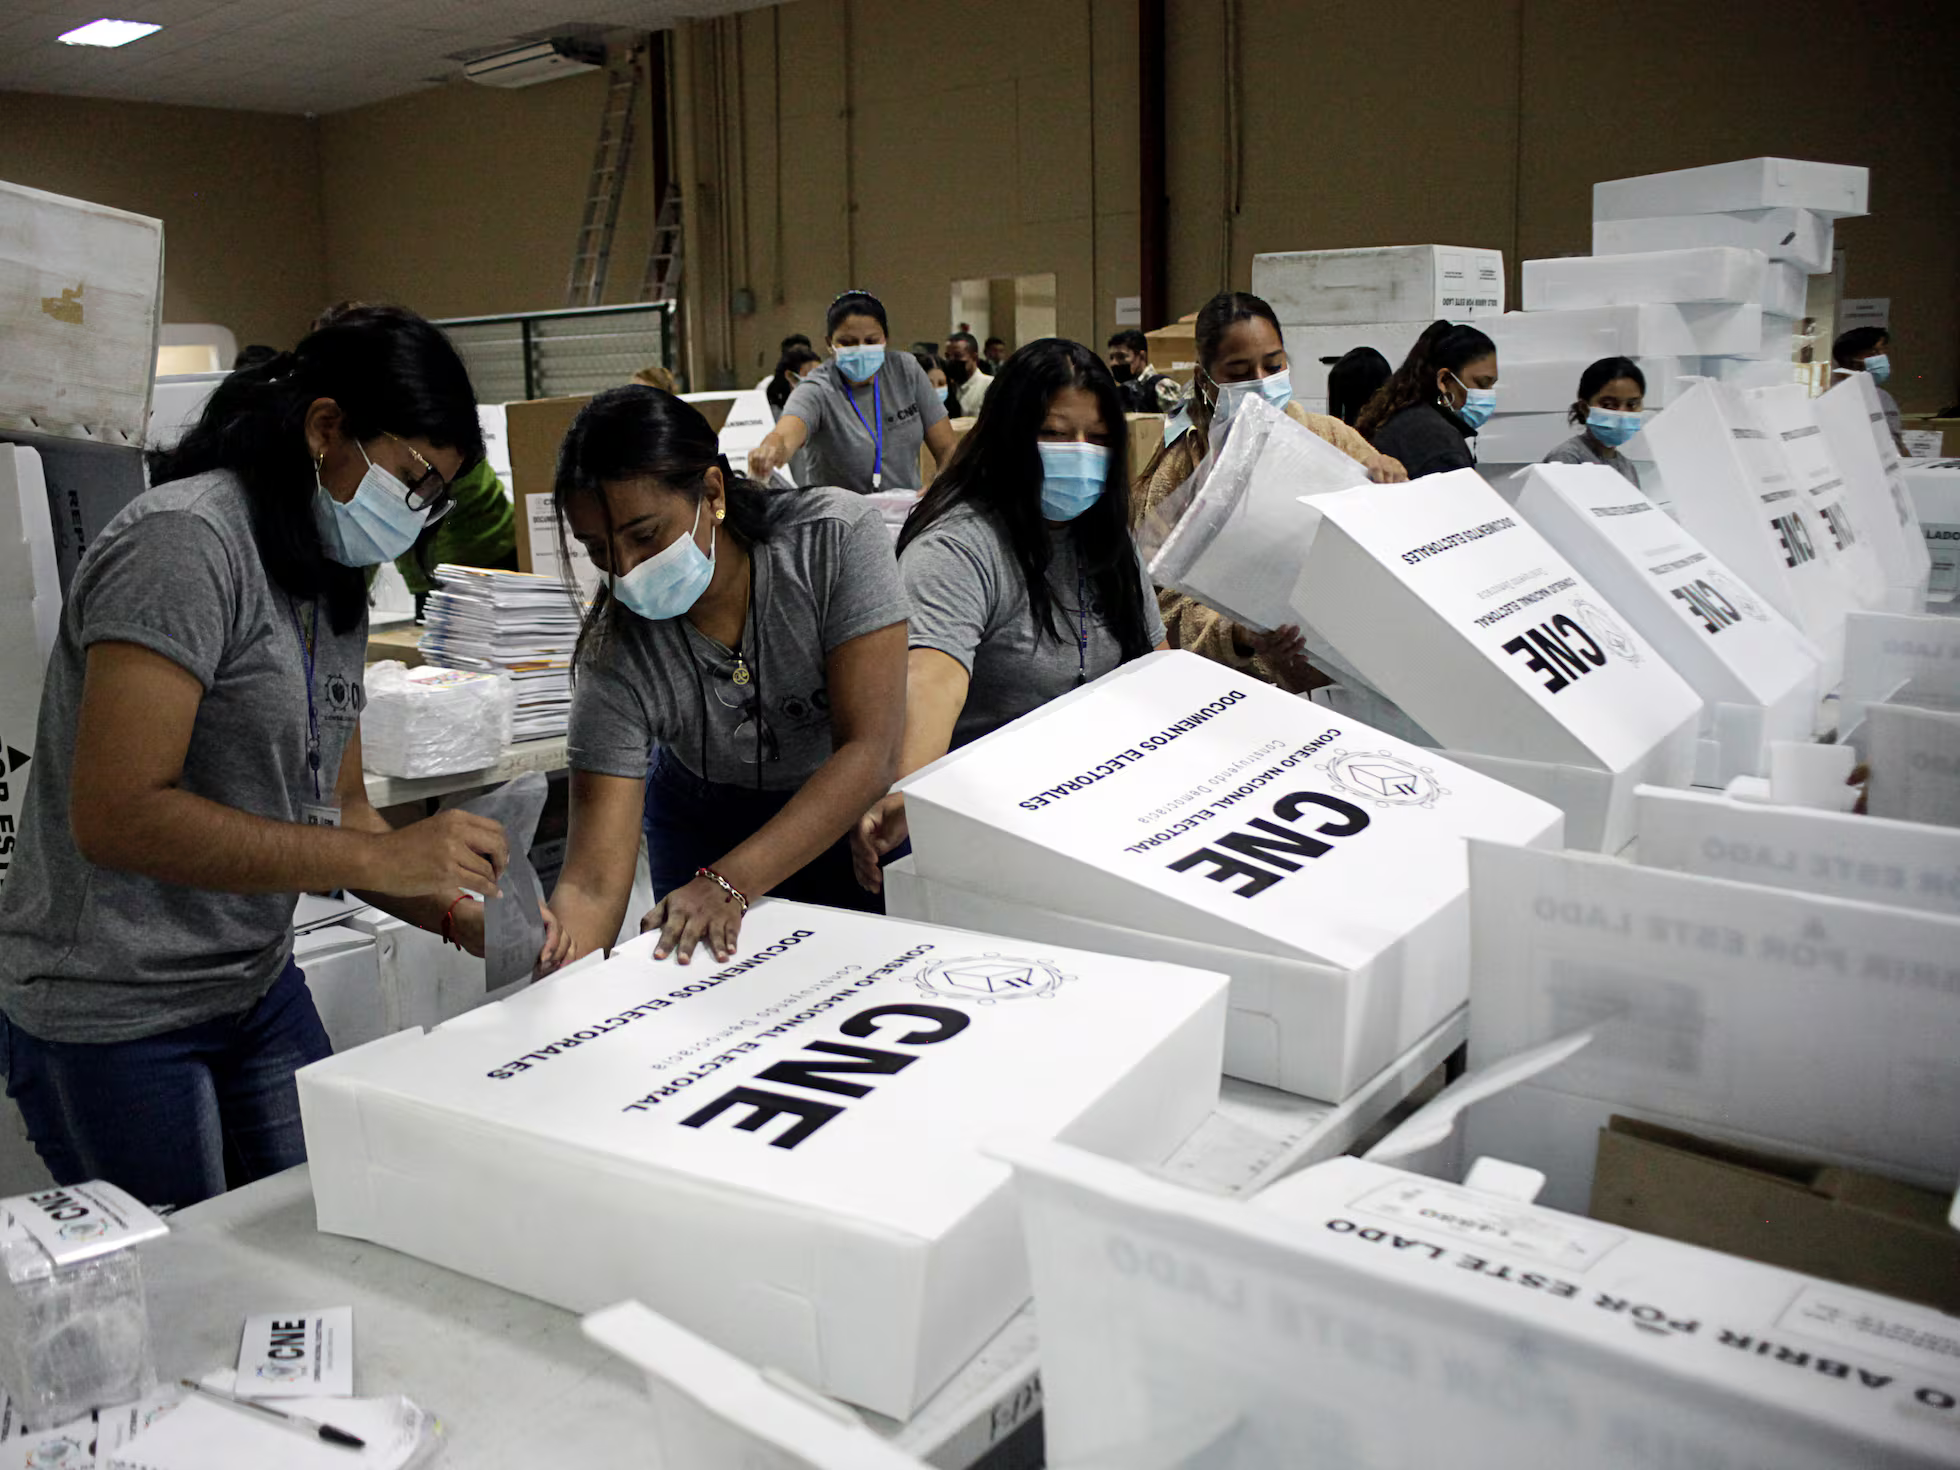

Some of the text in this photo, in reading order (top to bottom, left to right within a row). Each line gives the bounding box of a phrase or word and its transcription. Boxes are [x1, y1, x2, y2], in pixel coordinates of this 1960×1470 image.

[1401, 533, 1467, 565] ELECTORALES
[1771, 512, 1816, 568] CNE
[1926, 529, 1960, 541] LADO
[1473, 601, 1523, 628] ELECTORAL
[1670, 578, 1742, 634] CNE
[1501, 613, 1607, 694] CNE
[1019, 690, 1247, 811] DOCUMENTOS ELECTORALES
[1123, 728, 1342, 854] CONSEJO NACIONAL ELECTORAL
[1137, 740, 1286, 823] Construyendo Democracia
[1165, 790, 1370, 899] CNE
[487, 929, 816, 1080] DOCUMENTOS ELECTORALES
[621, 944, 936, 1113] CONSEJO NACIONAL ELECTORAL
[678, 1003, 971, 1150] CNE
[1325, 1218, 1445, 1261] LADO
[1456, 1252, 1582, 1300] ESTE
[267, 1319, 306, 1359] CNE
[1594, 1291, 1701, 1336] POR
[1717, 1327, 1897, 1389] ABRIR
